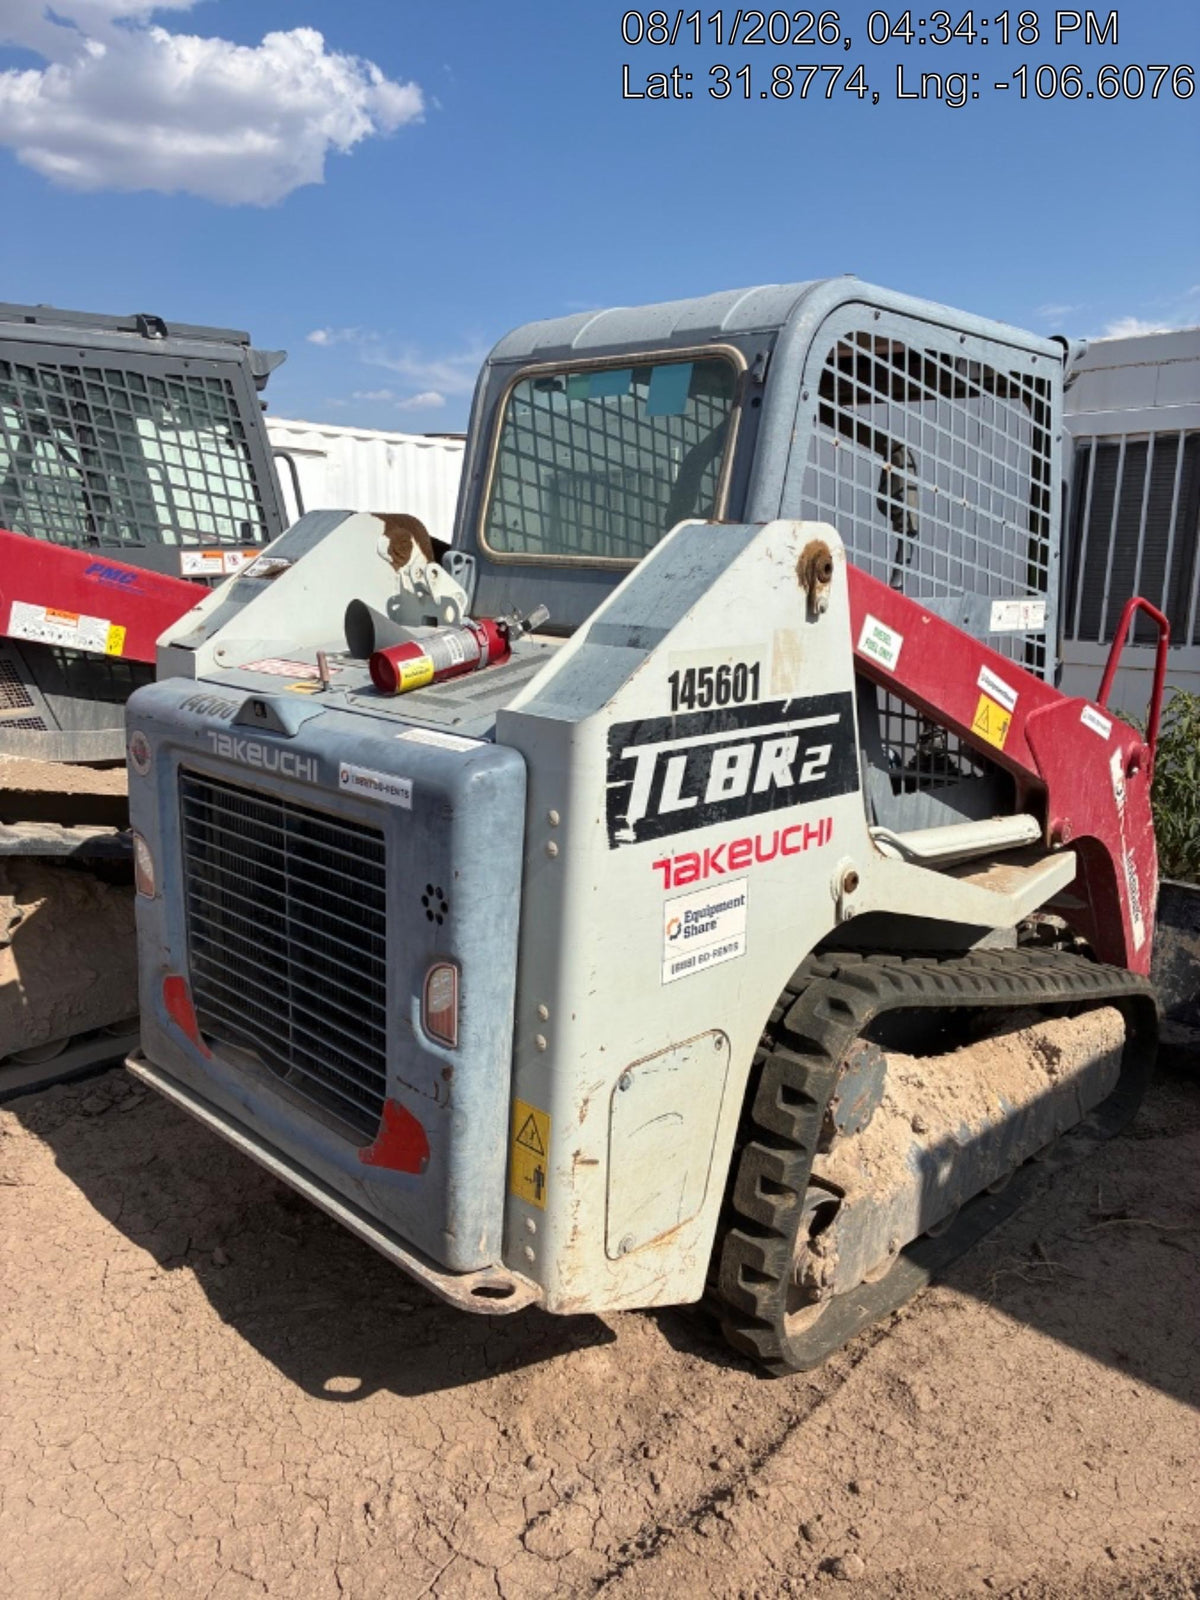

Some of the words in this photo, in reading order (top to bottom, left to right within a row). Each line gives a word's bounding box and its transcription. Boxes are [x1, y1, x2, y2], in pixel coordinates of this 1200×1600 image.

[85, 563, 137, 584] PMC
[668, 662, 760, 712] 145601
[684, 894, 745, 923] Equipment
[683, 920, 717, 939] Share
